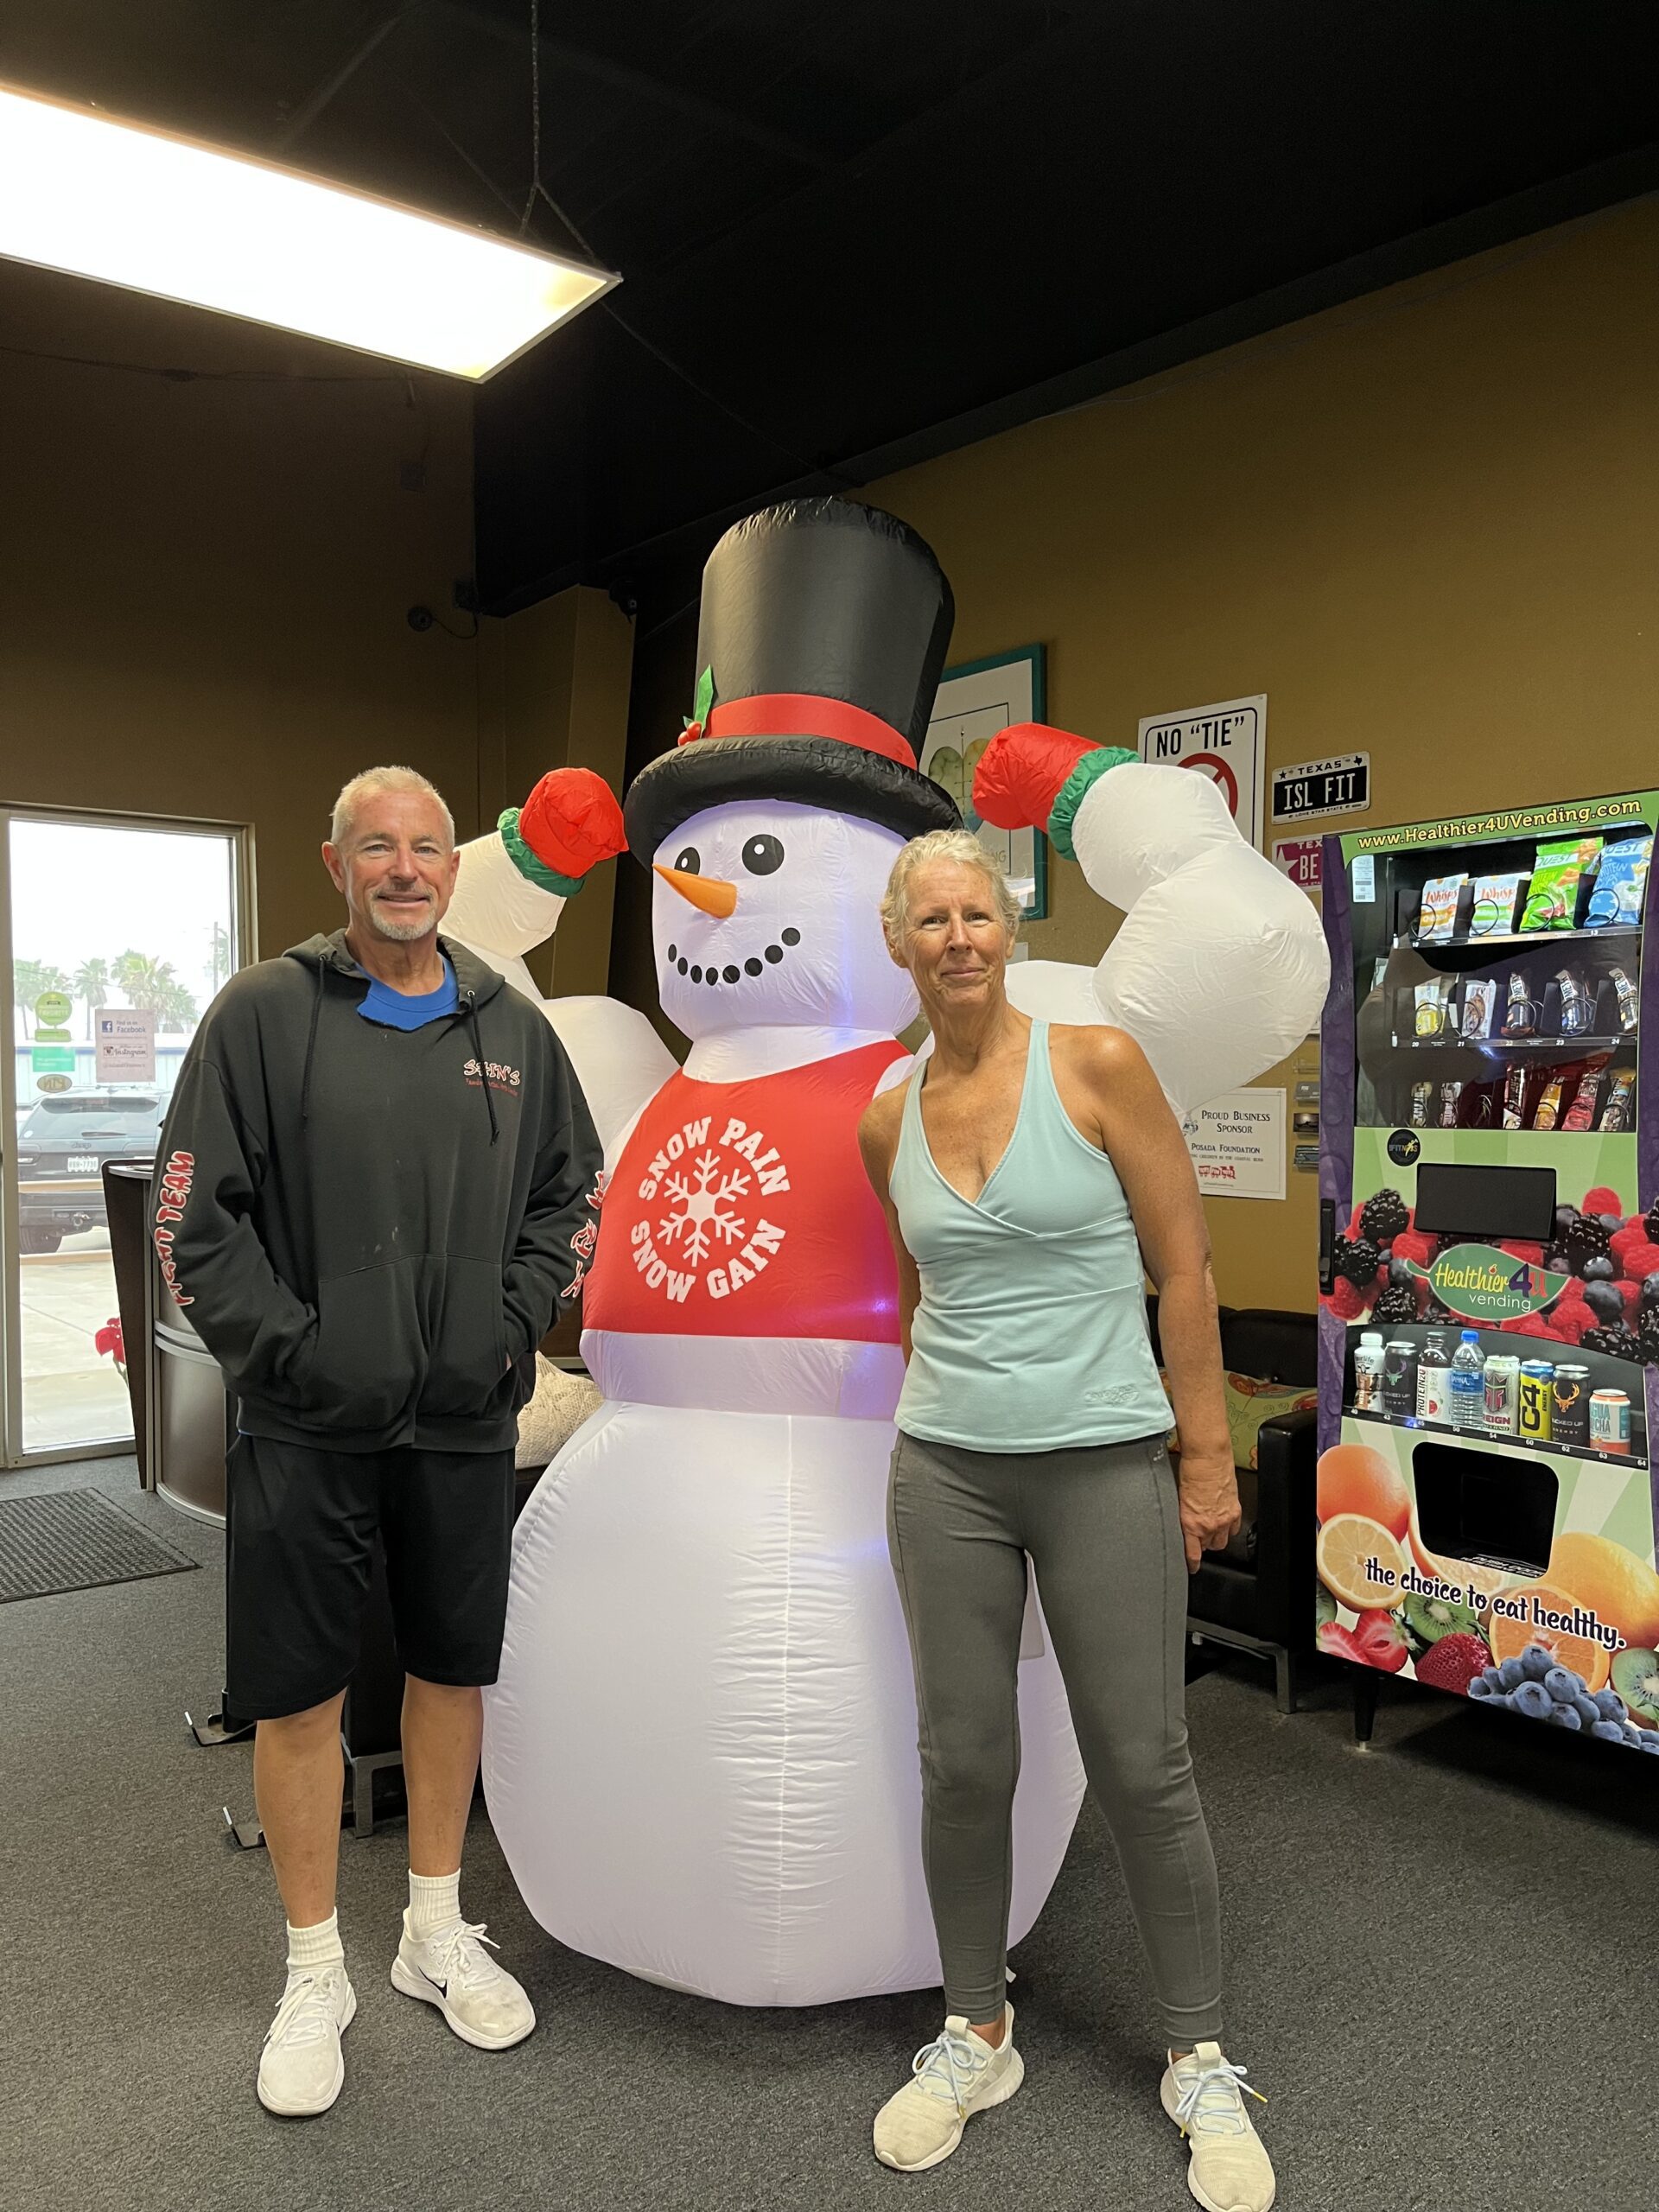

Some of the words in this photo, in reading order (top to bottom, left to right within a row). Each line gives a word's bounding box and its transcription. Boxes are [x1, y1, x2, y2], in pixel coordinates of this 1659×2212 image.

[1156, 728, 1182, 758] NO
[1297, 760, 1342, 775] TEXAS
[1283, 781, 1313, 810] ISL
[1325, 772, 1356, 804] FIT
[1358, 799, 1641, 849] www.Healthier4UVending.com
[1297, 840, 1323, 850] TEX
[1201, 1109, 1230, 1121] PROUD
[1233, 1110, 1271, 1122] BUSINESS
[1217, 1123, 1253, 1135] SPONSOR
[638, 1116, 712, 1201] SNOW
[718, 1117, 791, 1197] PAIN
[1191, 1142, 1217, 1153] POSADA
[1219, 1143, 1261, 1154] FOUNDATION
[156, 1150, 195, 1224] TEAM
[631, 1219, 696, 1303] SNOW
[706, 1218, 786, 1300] GAIN
[1469, 1294, 1532, 1313] vending
[1483, 1416, 1510, 1425] EIGN
[1522, 1384, 1541, 1431] C4
[1365, 1557, 1395, 1586] the
[1401, 1567, 1462, 1605] choice
[1466, 1584, 1489, 1610] to
[1493, 1596, 1529, 1622] eat
[1533, 1597, 1627, 1649] healthy.
